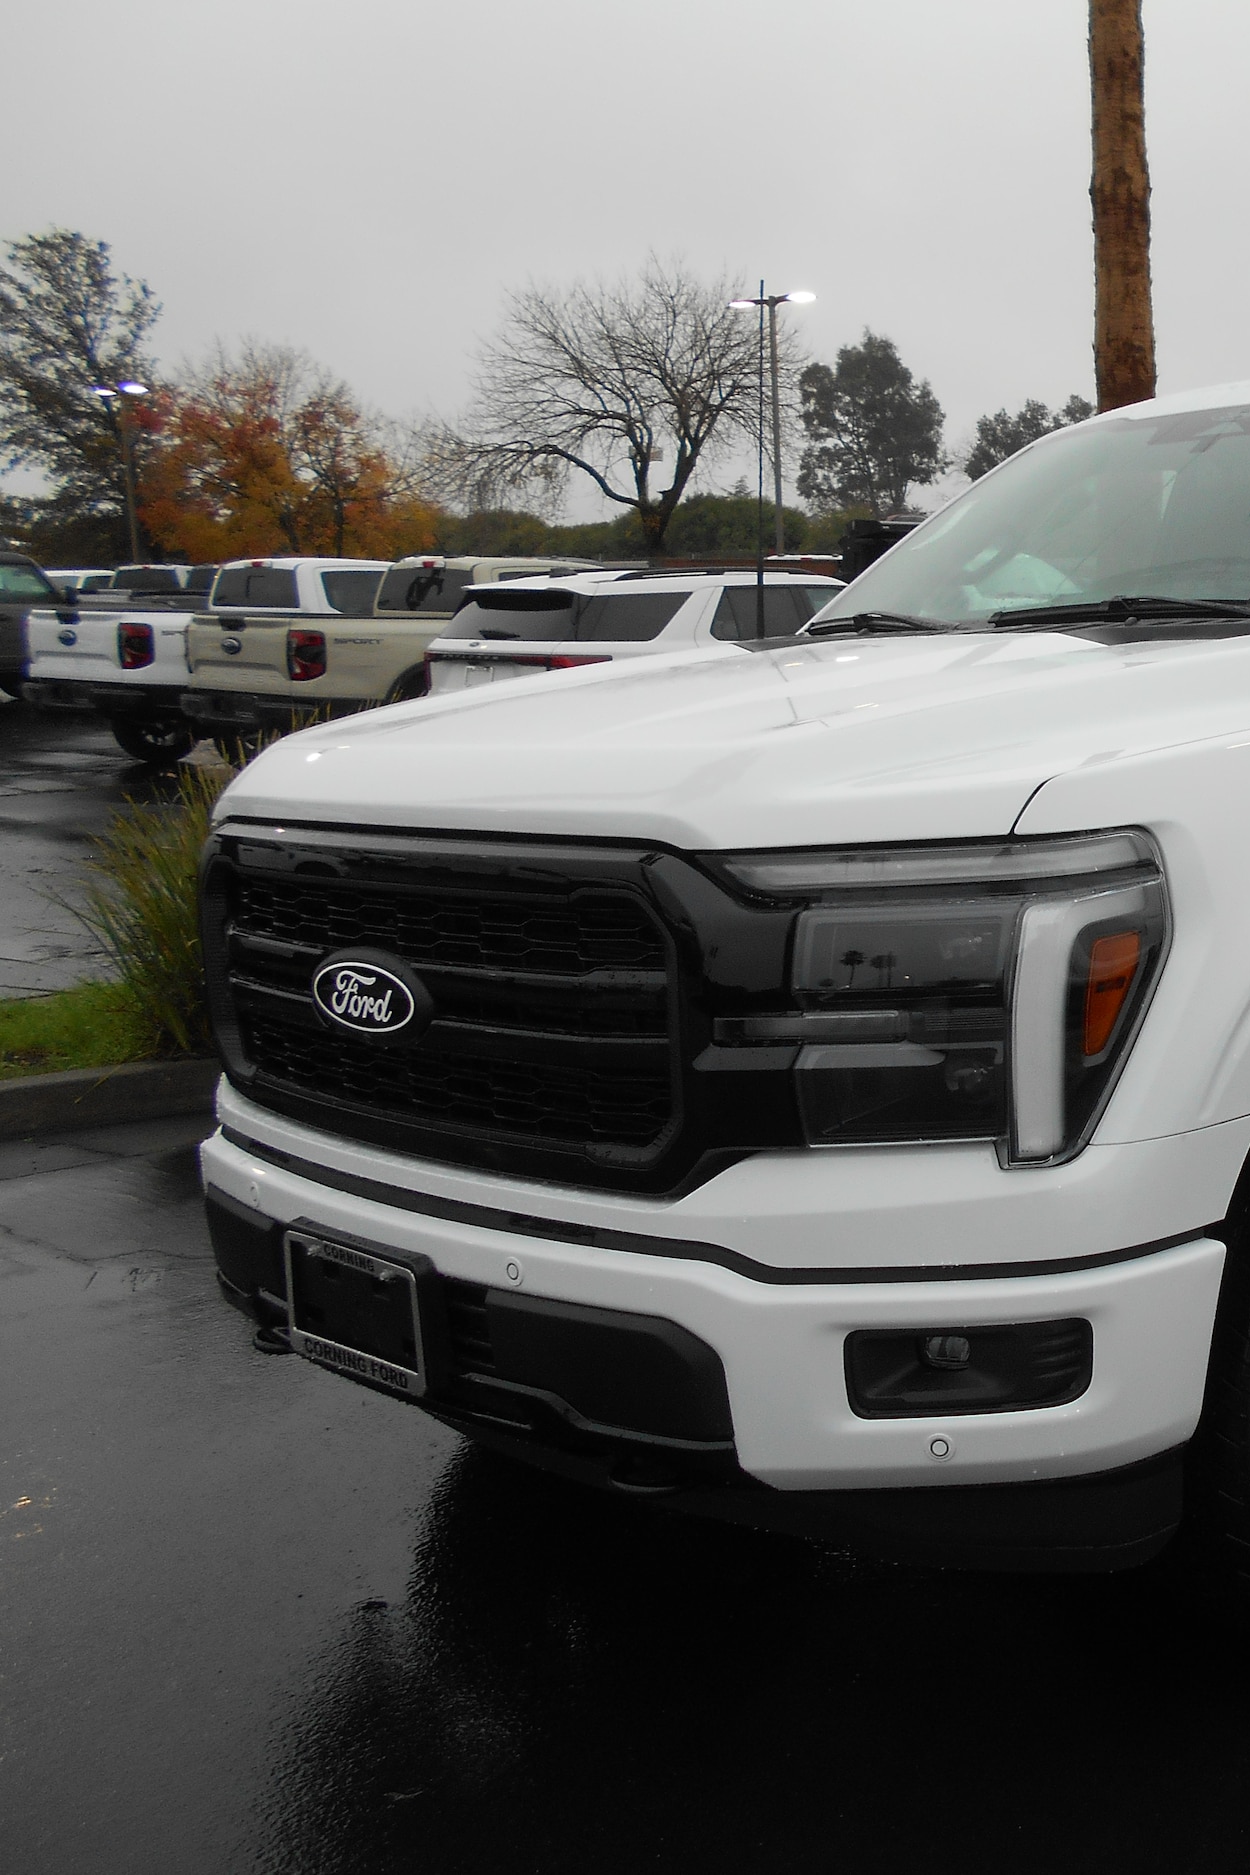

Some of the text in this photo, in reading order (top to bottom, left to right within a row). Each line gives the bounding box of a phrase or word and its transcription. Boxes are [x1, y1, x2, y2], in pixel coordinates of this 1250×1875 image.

[331, 969, 393, 1023] Ford
[323, 1244, 376, 1272] CORNING
[303, 1337, 409, 1389] CORNING FORD
